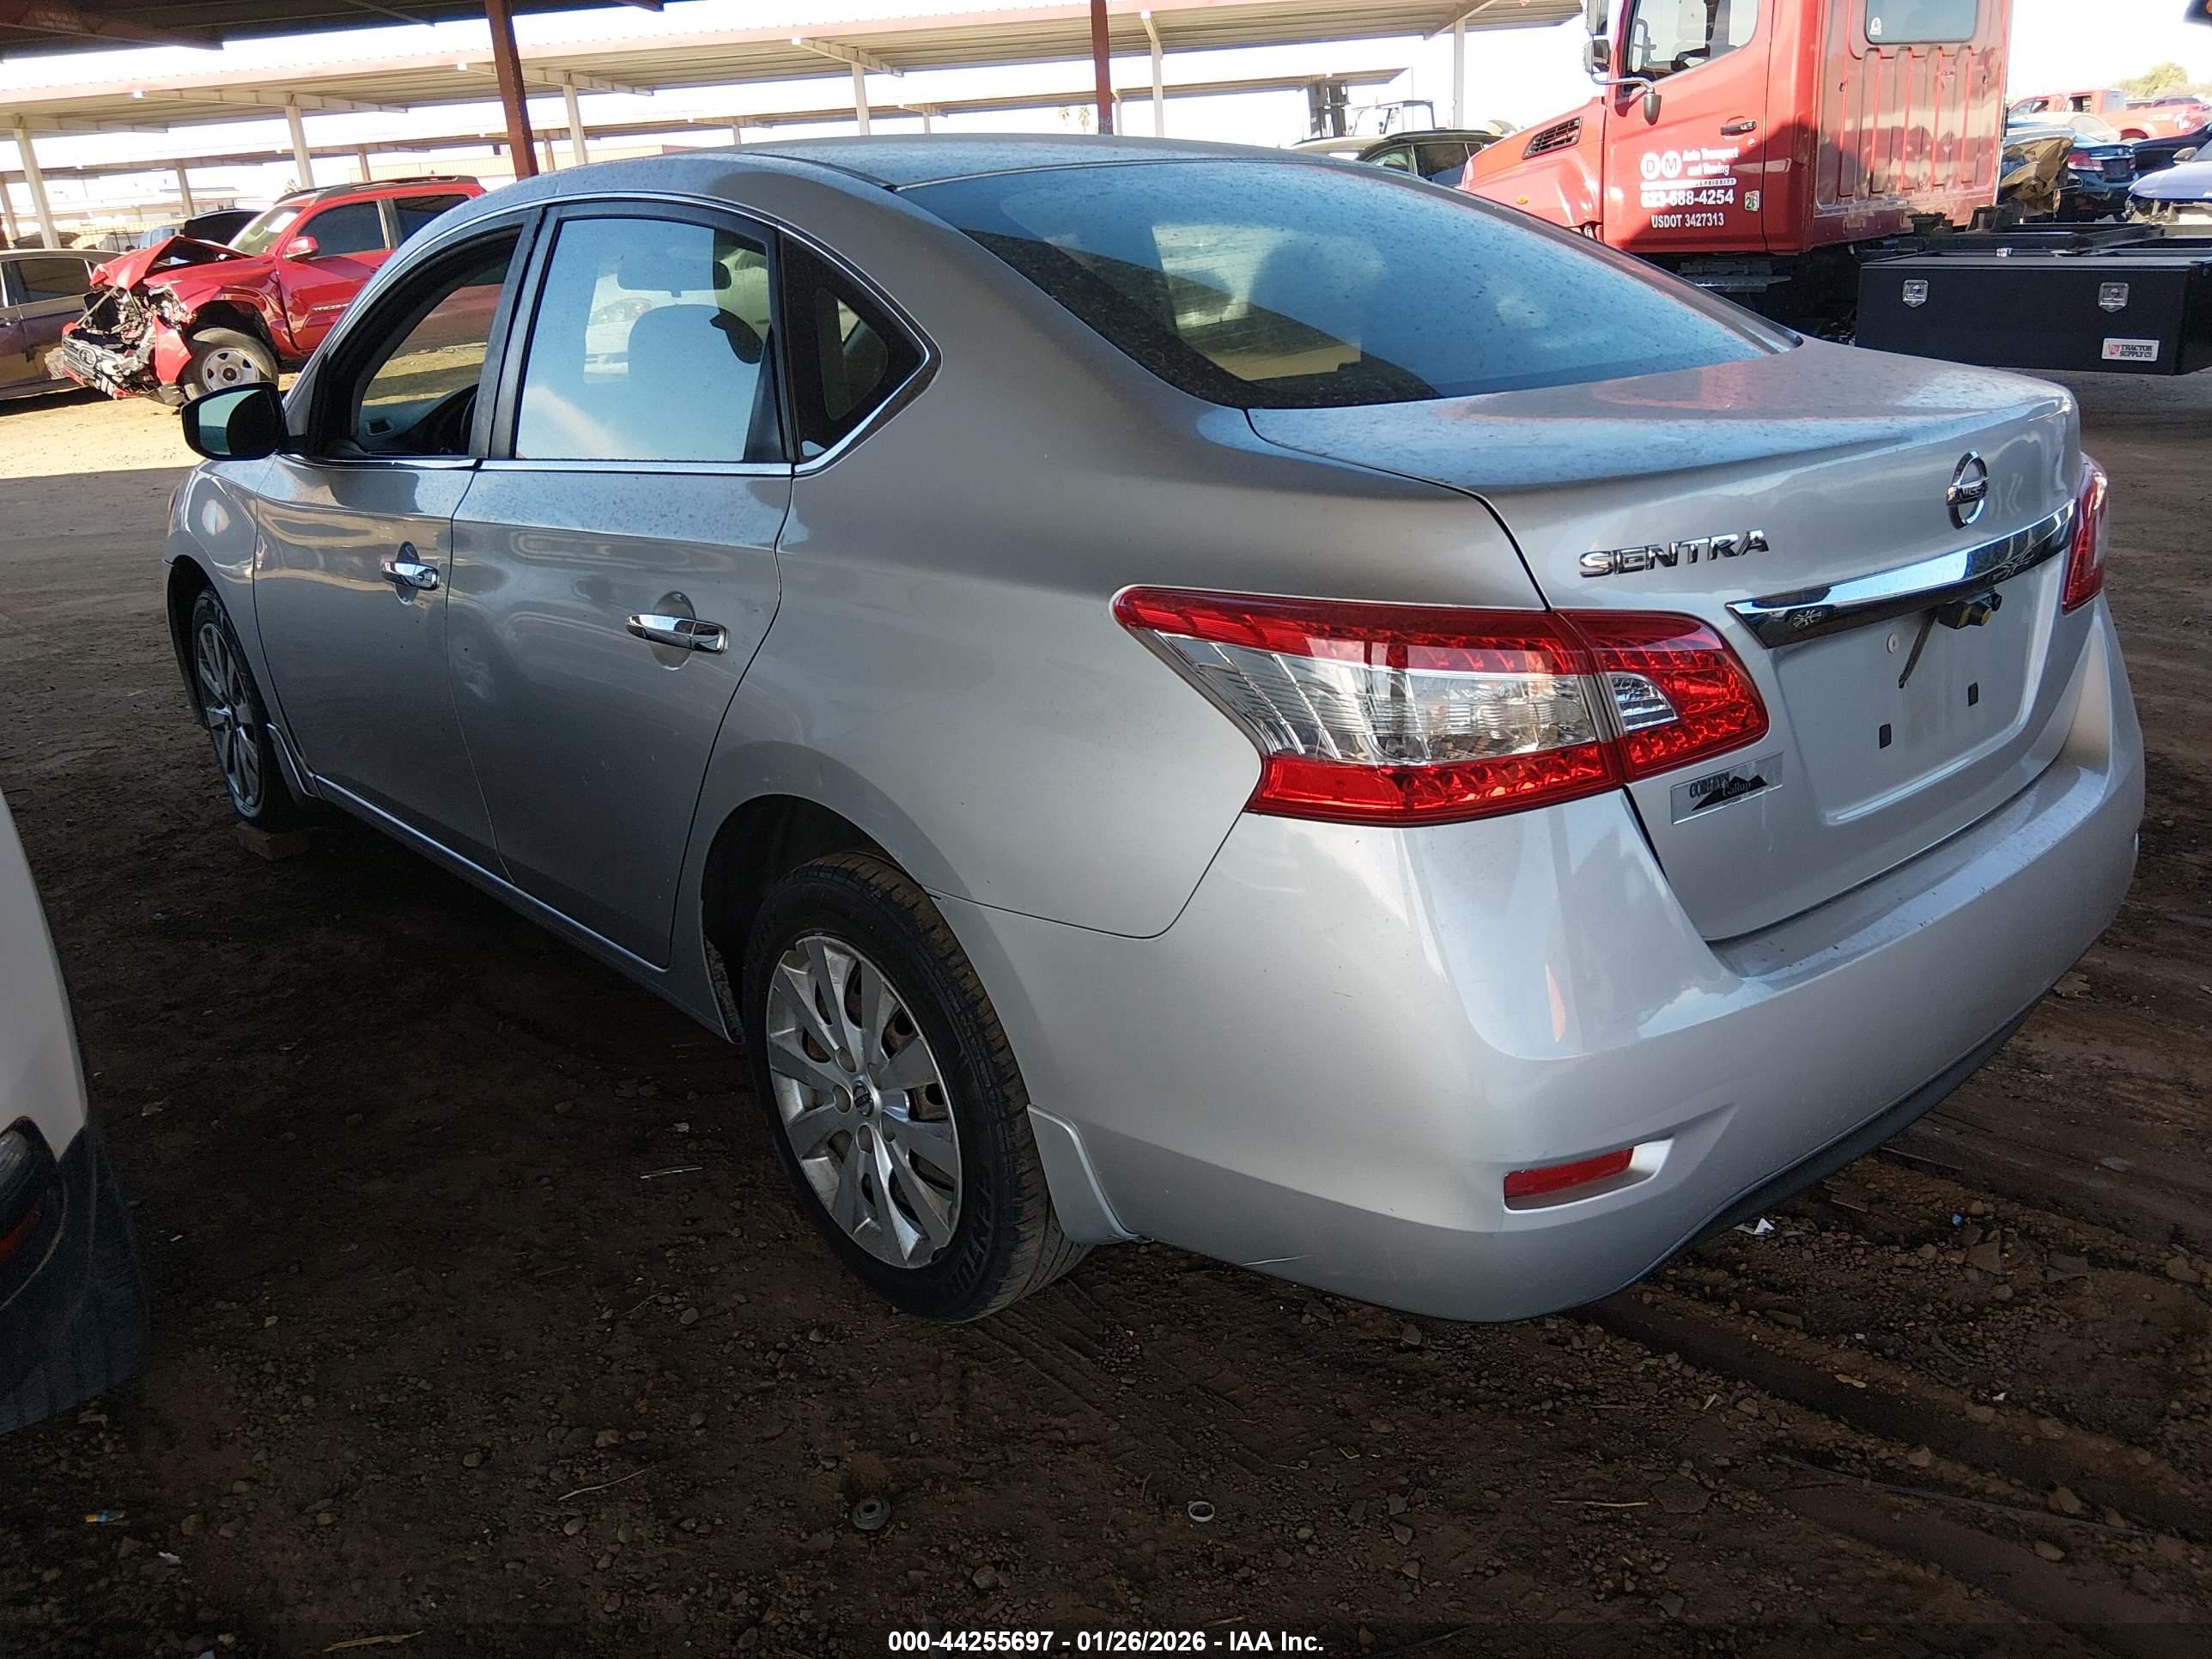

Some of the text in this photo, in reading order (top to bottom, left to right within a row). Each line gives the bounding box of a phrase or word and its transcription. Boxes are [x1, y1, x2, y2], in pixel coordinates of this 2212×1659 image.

[1651, 212, 1724, 228] USDOT 3427313
[1579, 529, 1770, 578] SENTRA
